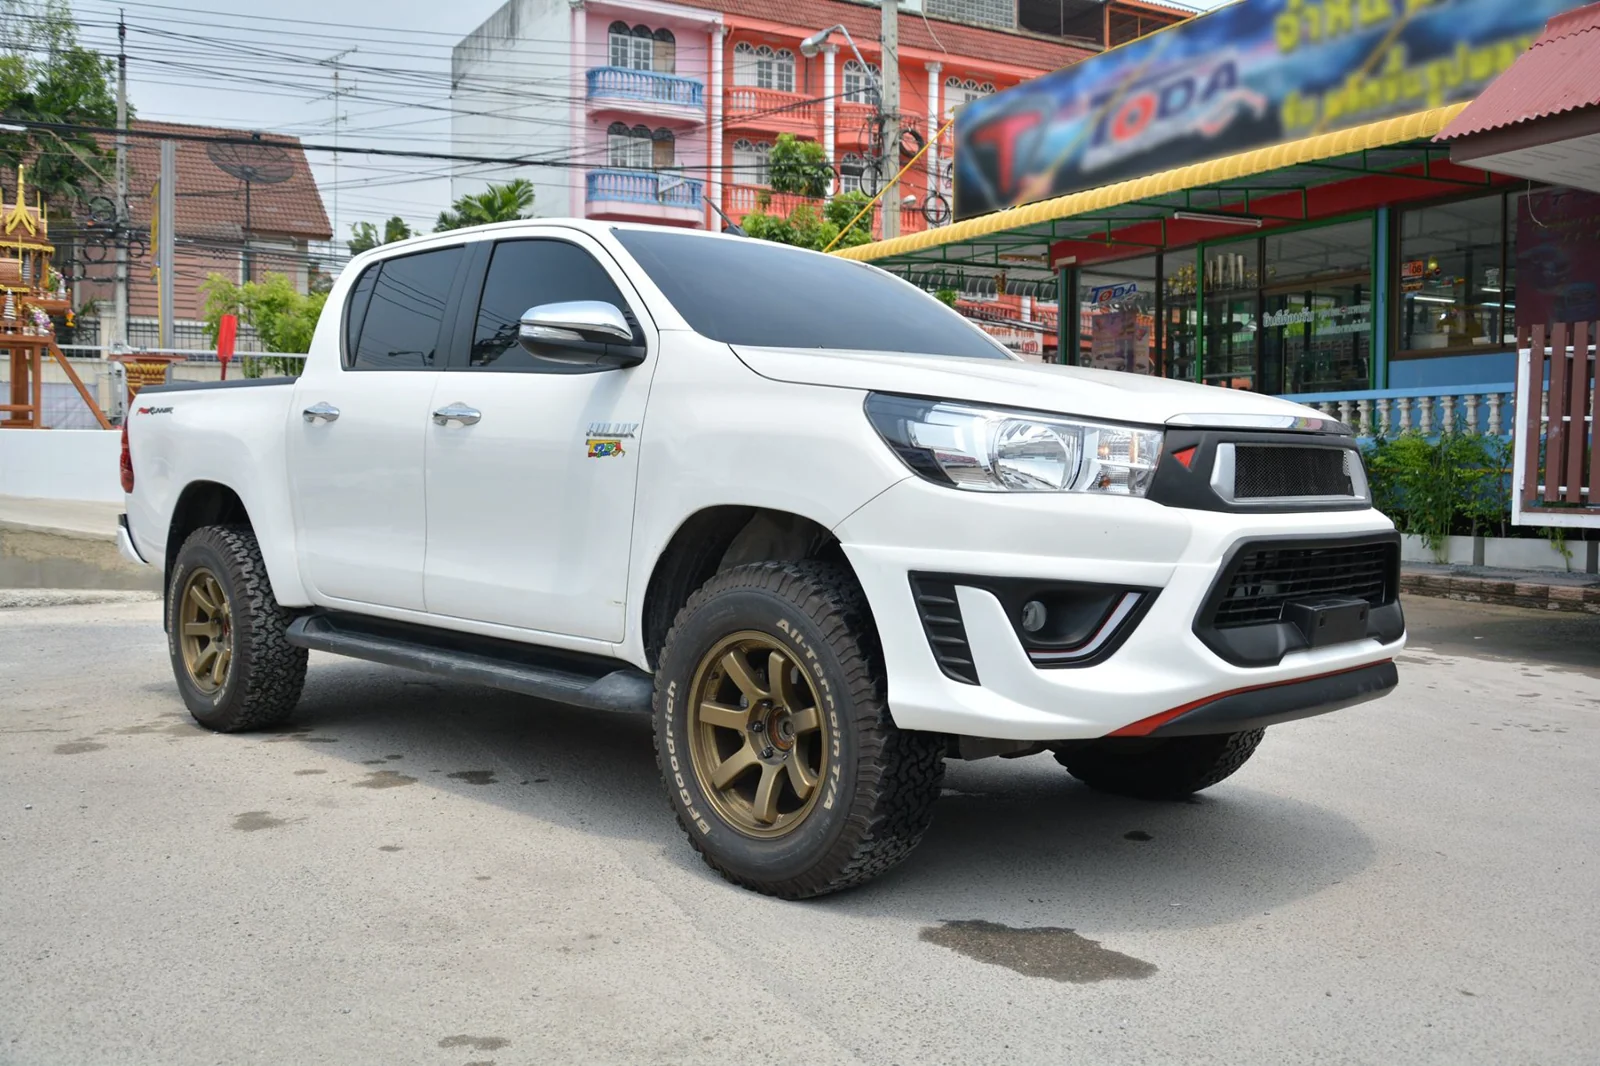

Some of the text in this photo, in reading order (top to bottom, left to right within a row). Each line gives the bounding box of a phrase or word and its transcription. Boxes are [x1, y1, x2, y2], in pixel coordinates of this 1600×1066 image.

[1088, 56, 1239, 148] TODA
[1091, 281, 1138, 304] TODA
[775, 618, 842, 758] All-Terrain
[664, 680, 712, 836] BFGoodrich
